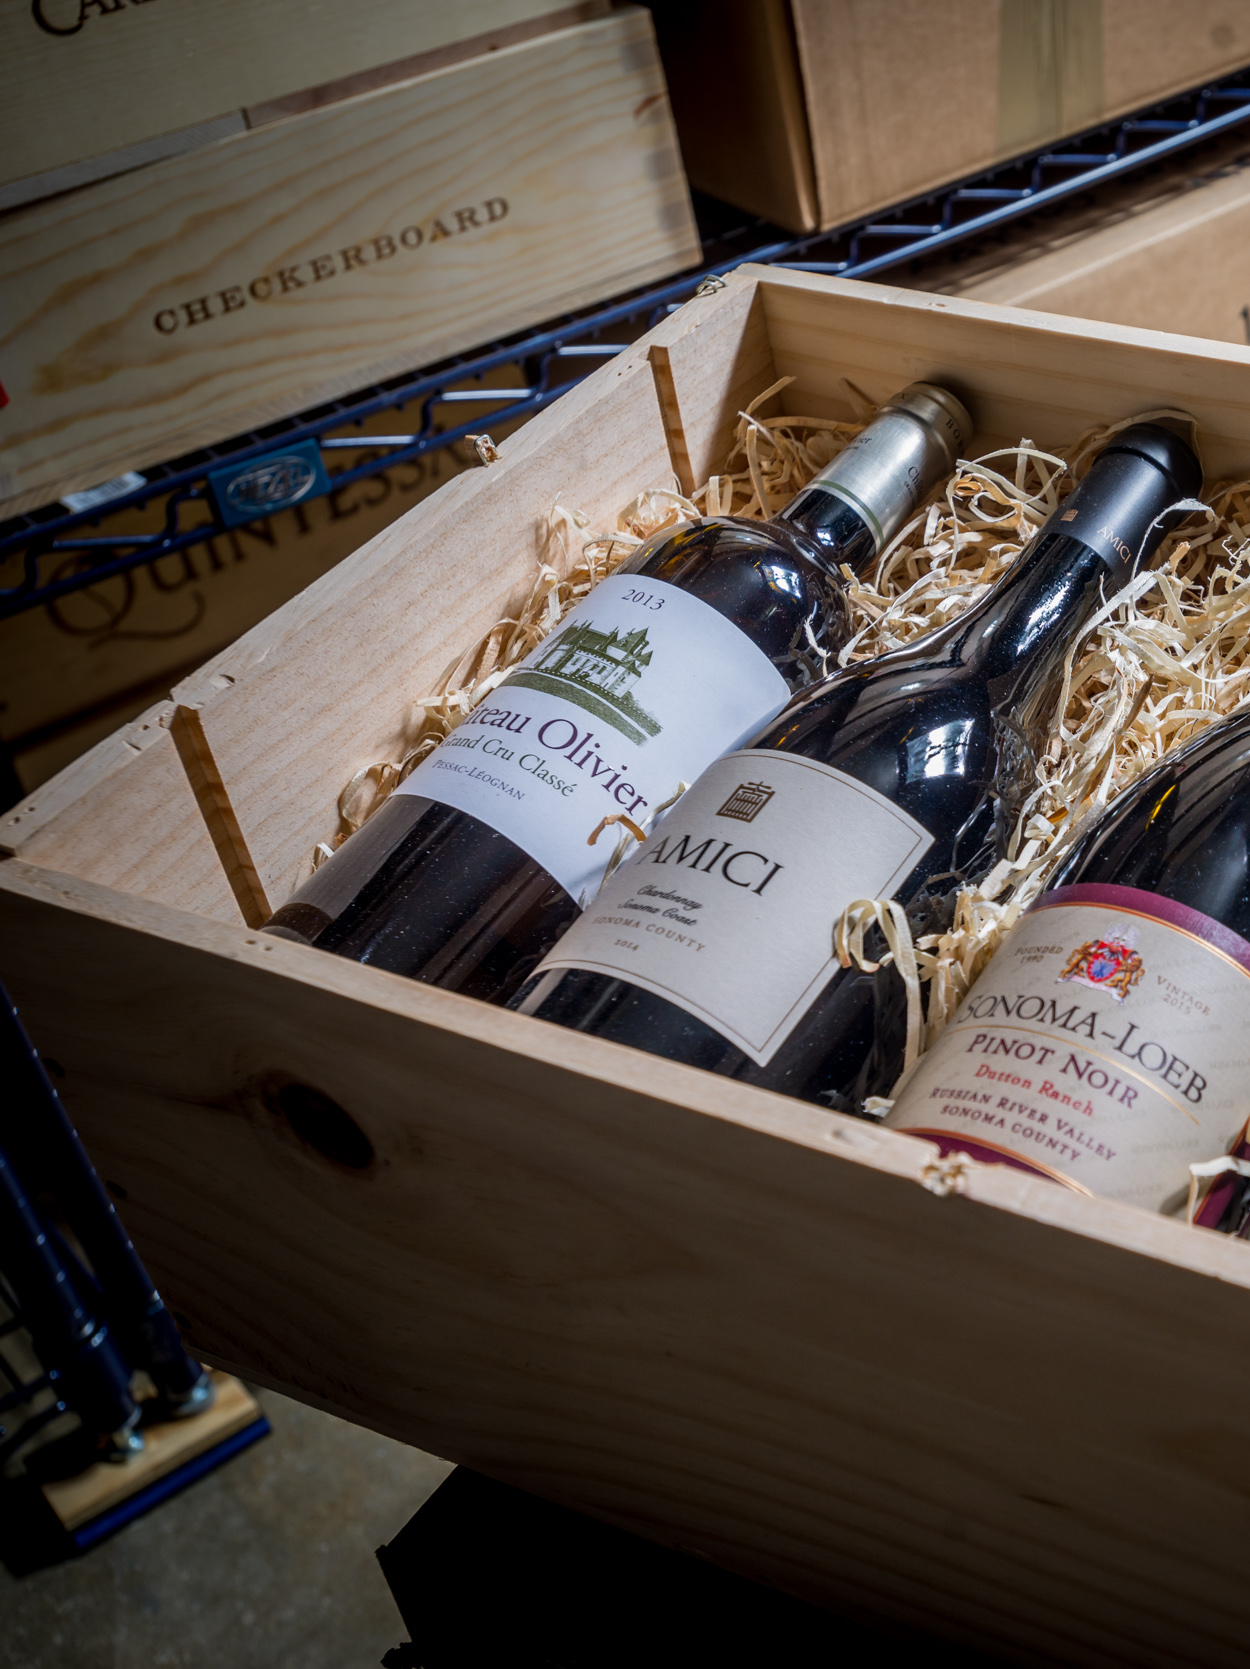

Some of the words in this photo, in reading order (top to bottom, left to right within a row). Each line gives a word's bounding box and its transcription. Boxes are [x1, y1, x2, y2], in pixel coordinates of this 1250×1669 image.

[153, 196, 511, 336] CHECKERBOARD
[1096, 526, 1131, 564] AMICI
[621, 588, 665, 610] 2013
[481, 738, 515, 761] Cru
[518, 752, 578, 797] Classé
[537, 718, 648, 816] Olivier
[634, 834, 785, 896] AMICI
[617, 898, 661, 914] Sonoma
[661, 907, 698, 926] Coast
[636, 884, 704, 911] Chardonnay
[591, 916, 642, 929] SONOMA
[645, 923, 706, 952] COUNTY
[613, 938, 640, 952] 2014
[1014, 946, 1064, 955] FOUNDED
[1019, 955, 1044, 964] 1990
[1157, 975, 1211, 1016] VINTAGE
[1162, 993, 1192, 1015] 2015
[956, 994, 1208, 1105] SONOMA-LOEB
[966, 1033, 1056, 1066] PINOT
[1059, 1053, 1140, 1110] NOIR
[973, 1063, 1033, 1090] Dutton
[1037, 1079, 1095, 1117] Ranch
[929, 1087, 993, 1105] RUSSIAN
[997, 1096, 1049, 1125] RIVER
[1055, 1117, 1118, 1161] VALLEY
[940, 1104, 1006, 1129] SONOMA
[1010, 1122, 1082, 1161] COUNTY
